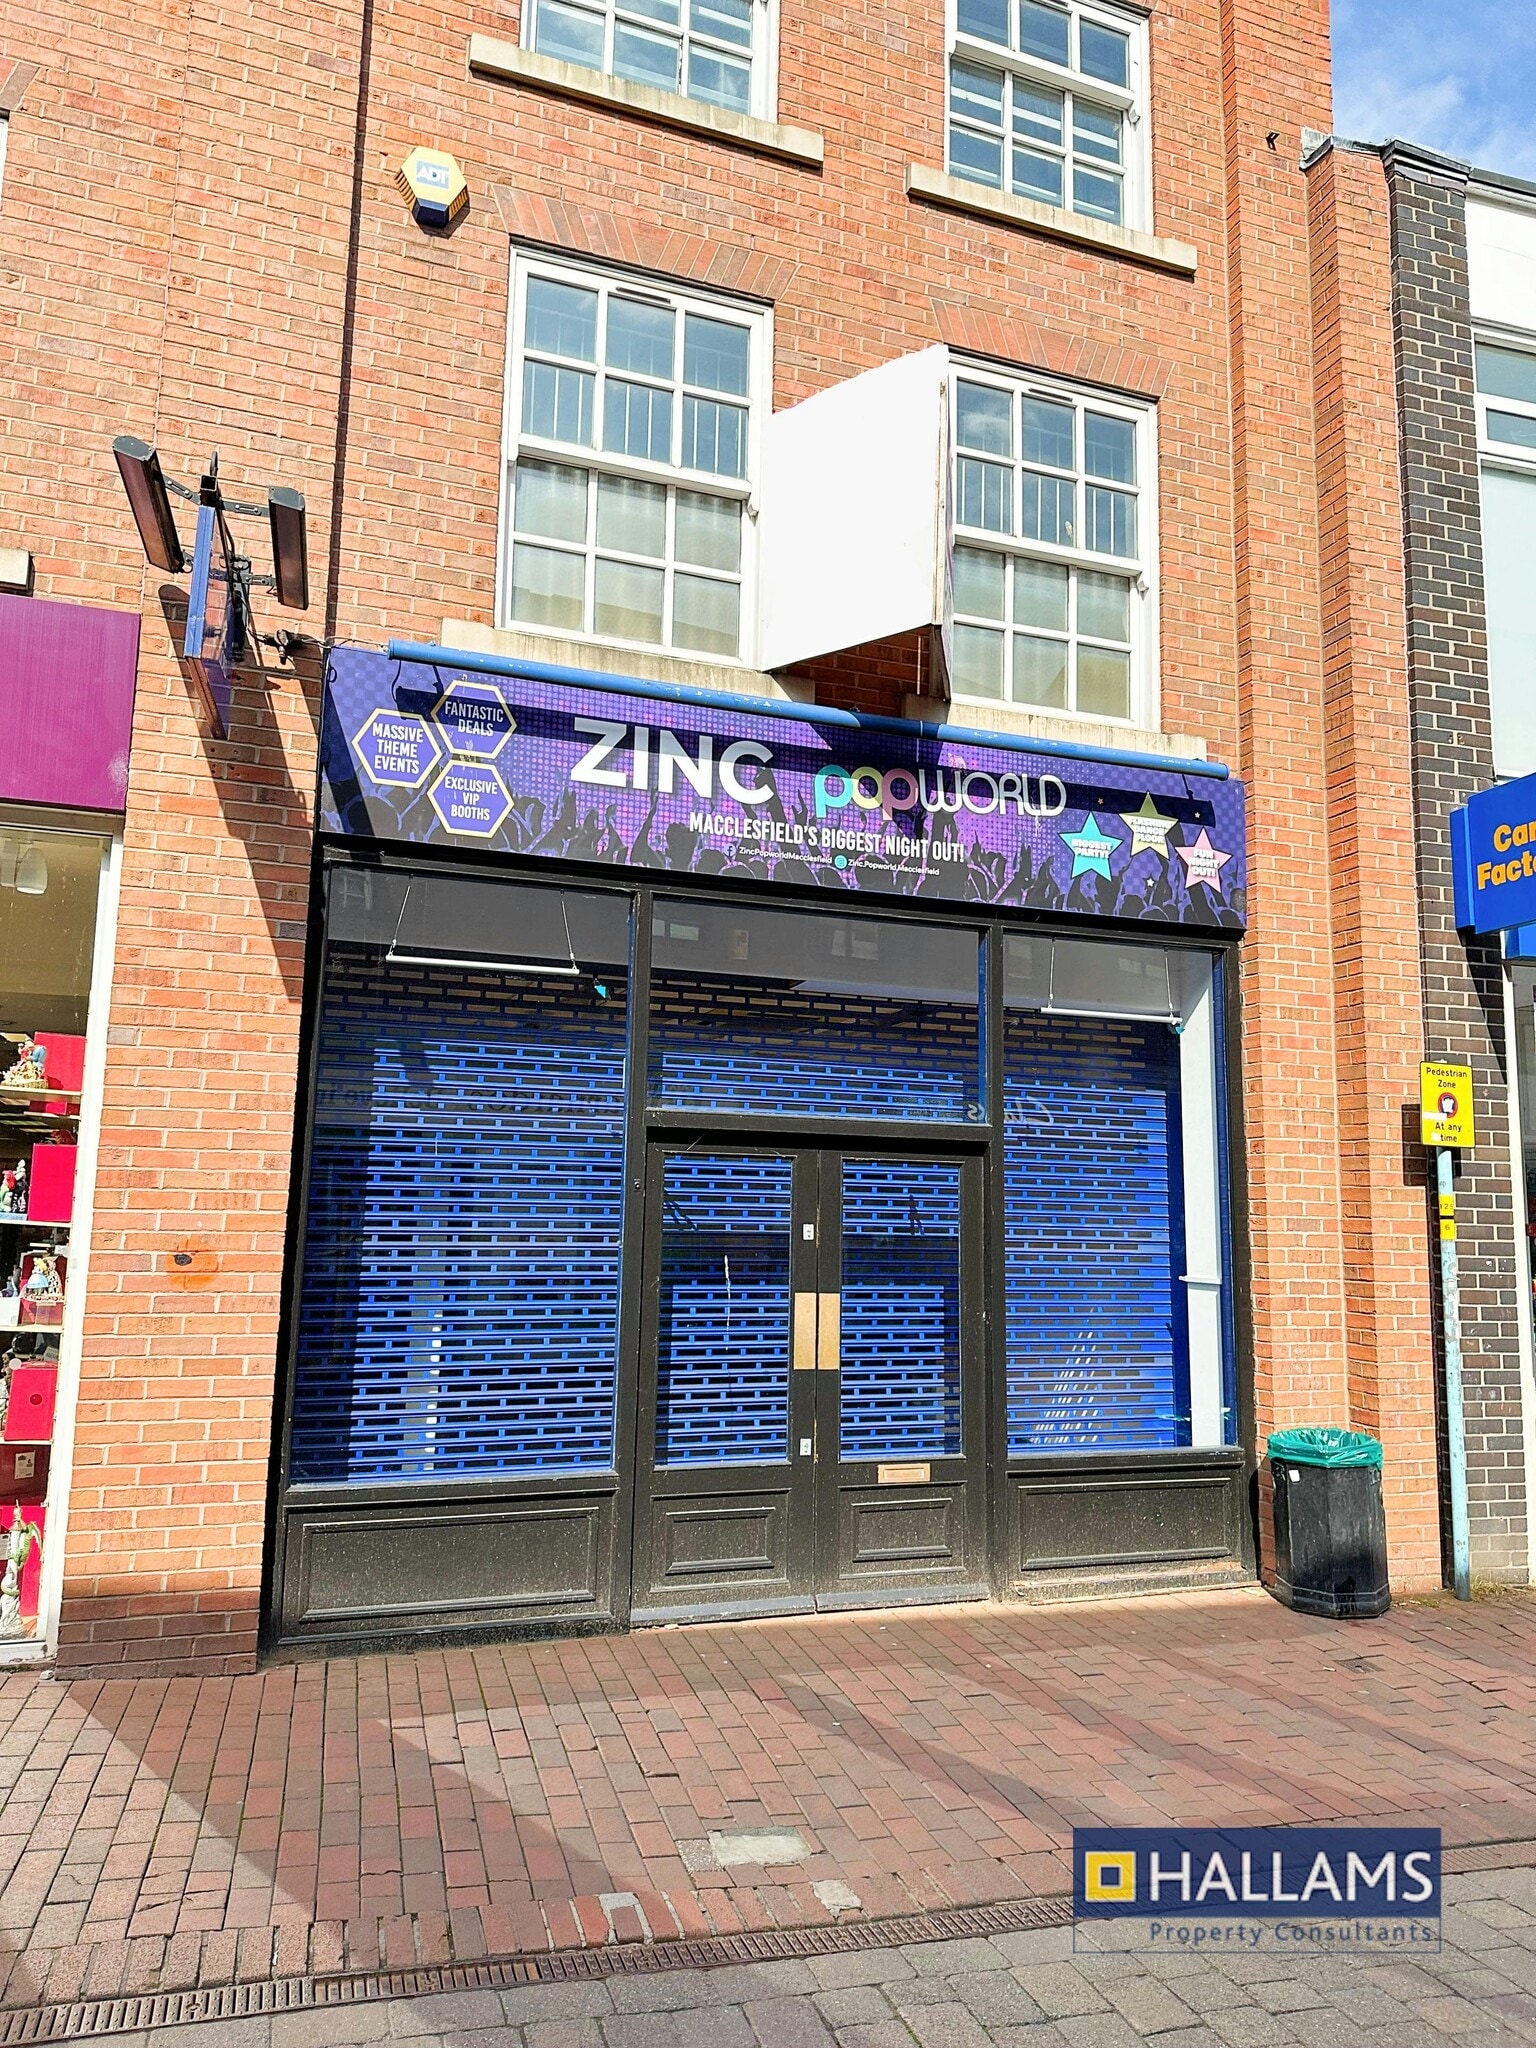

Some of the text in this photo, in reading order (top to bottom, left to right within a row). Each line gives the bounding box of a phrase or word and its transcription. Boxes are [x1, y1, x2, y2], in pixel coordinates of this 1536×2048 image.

[417, 165, 449, 185] ADT
[444, 701, 504, 722] FANTASTIC
[372, 722, 423, 743] MASSIVE
[458, 719, 494, 737] DEALS
[376, 739, 418, 758] THEME
[374, 755, 419, 774] EVENTS
[570, 716, 775, 805] ZINC
[444, 776, 498, 795] EXCLUSIVE
[462, 792, 480, 806] VIP
[451, 804, 490, 821] BOOTHS
[689, 811, 965, 863] MACCLESFIELD'S BIGGEST NIGHT OUT!
[1071, 838, 1113, 851] BIGGEST
[1188, 856, 1218, 868] NIGHT
[1193, 848, 1214, 859] FUN
[1476, 850, 1536, 890] Fact
[1426, 1067, 1468, 1078] Pedestrian
[1438, 1079, 1456, 1088] Zone
[1435, 1122, 1462, 1132] At any
[1440, 1134, 1457, 1142] time
